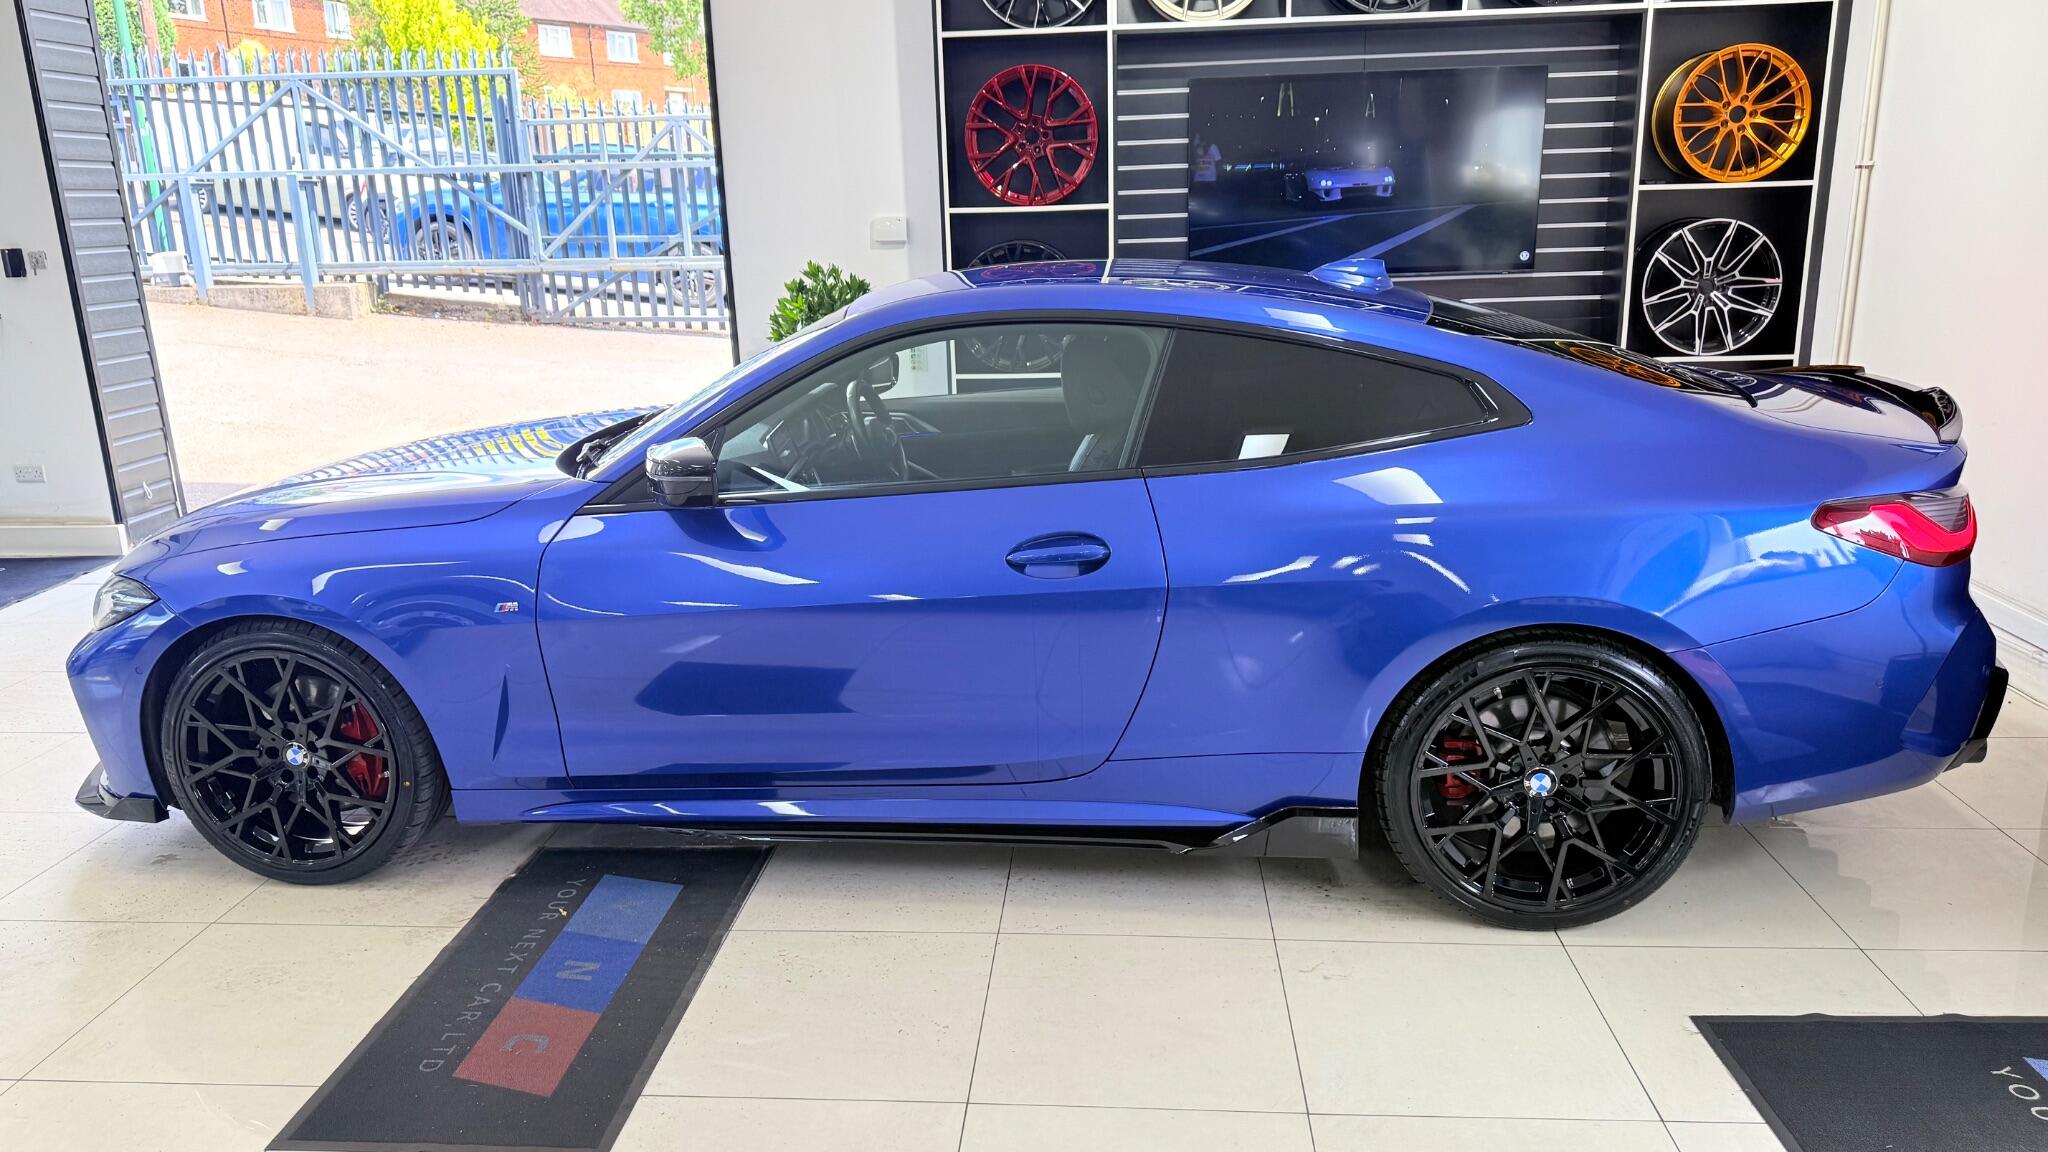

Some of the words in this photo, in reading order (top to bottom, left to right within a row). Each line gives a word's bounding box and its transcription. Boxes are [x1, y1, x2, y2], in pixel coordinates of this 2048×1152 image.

[537, 878, 588, 921] YOUR
[497, 928, 547, 975] NEXT
[556, 960, 600, 982] N
[502, 1033, 550, 1055] C
